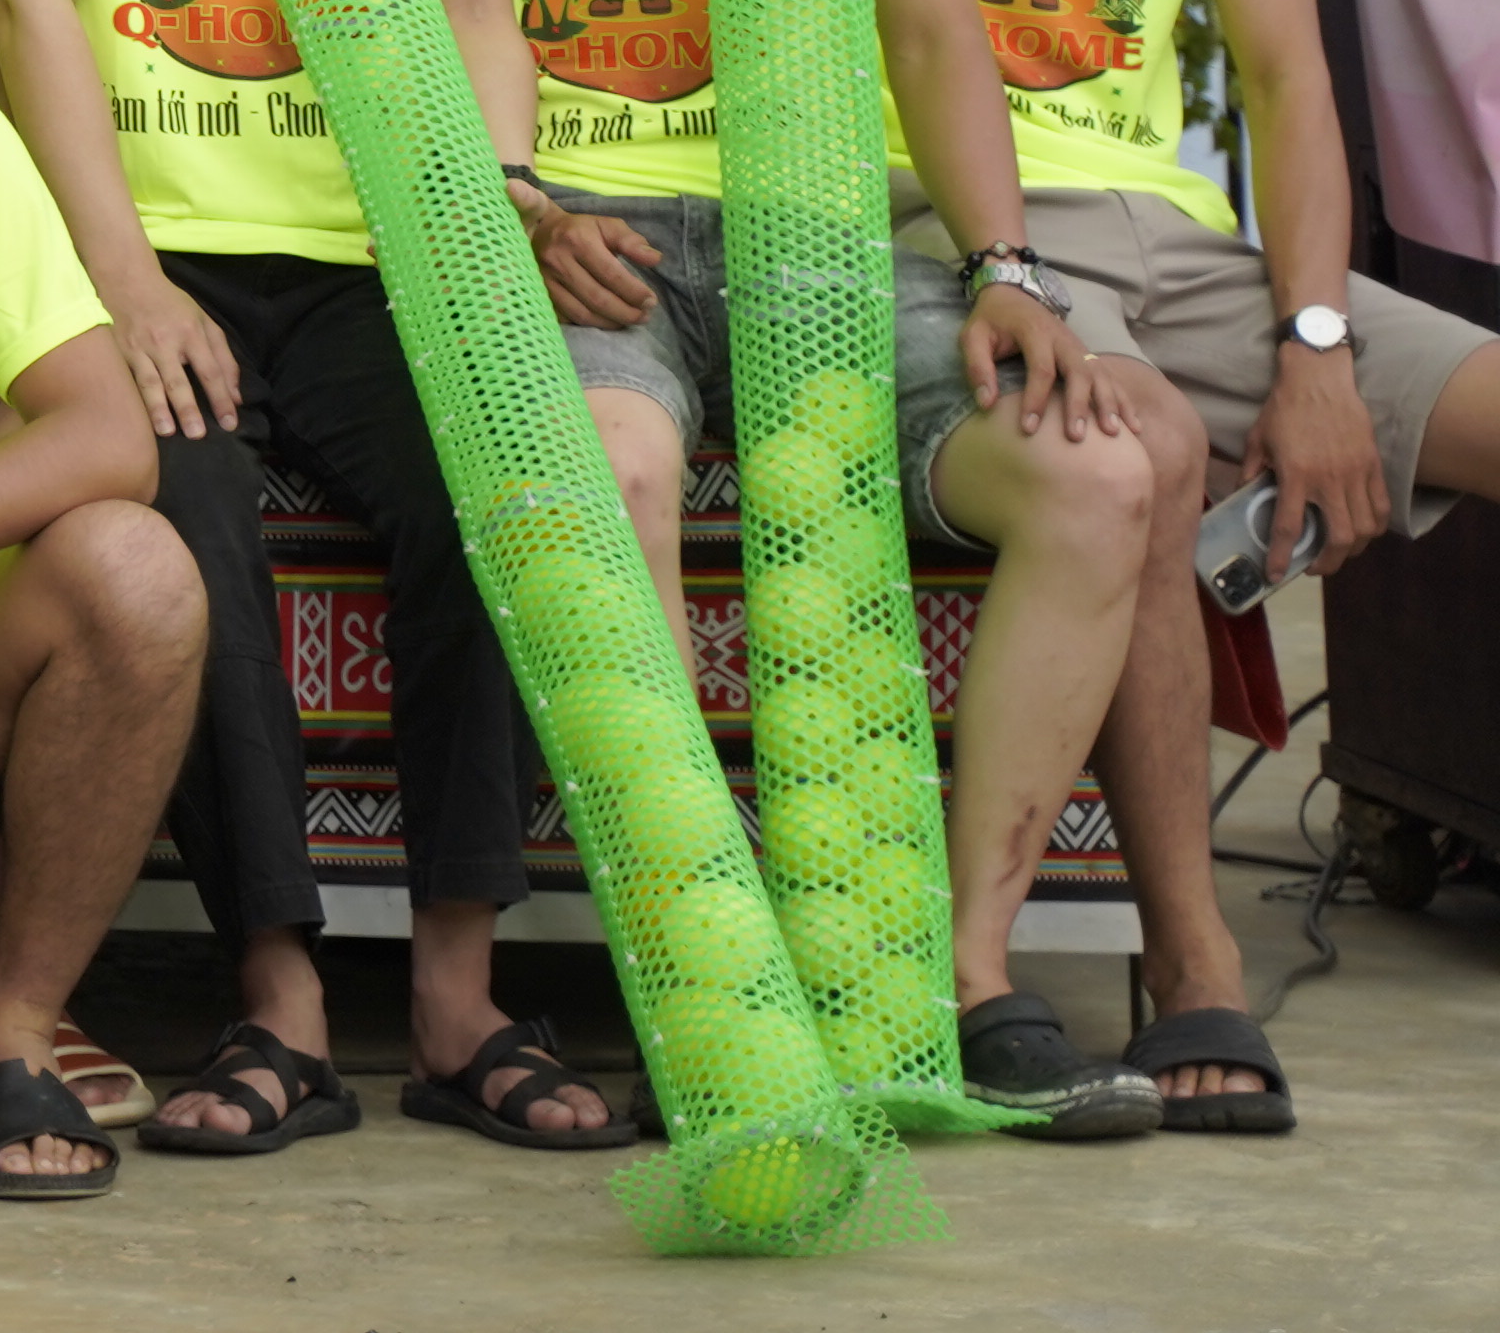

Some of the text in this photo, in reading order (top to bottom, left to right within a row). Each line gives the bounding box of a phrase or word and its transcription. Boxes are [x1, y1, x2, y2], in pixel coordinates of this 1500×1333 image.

[157, 89, 188, 135] tới
[197, 91, 241, 137] nơi
[547, 108, 582, 150] tới
[589, 103, 633, 145] nơi
